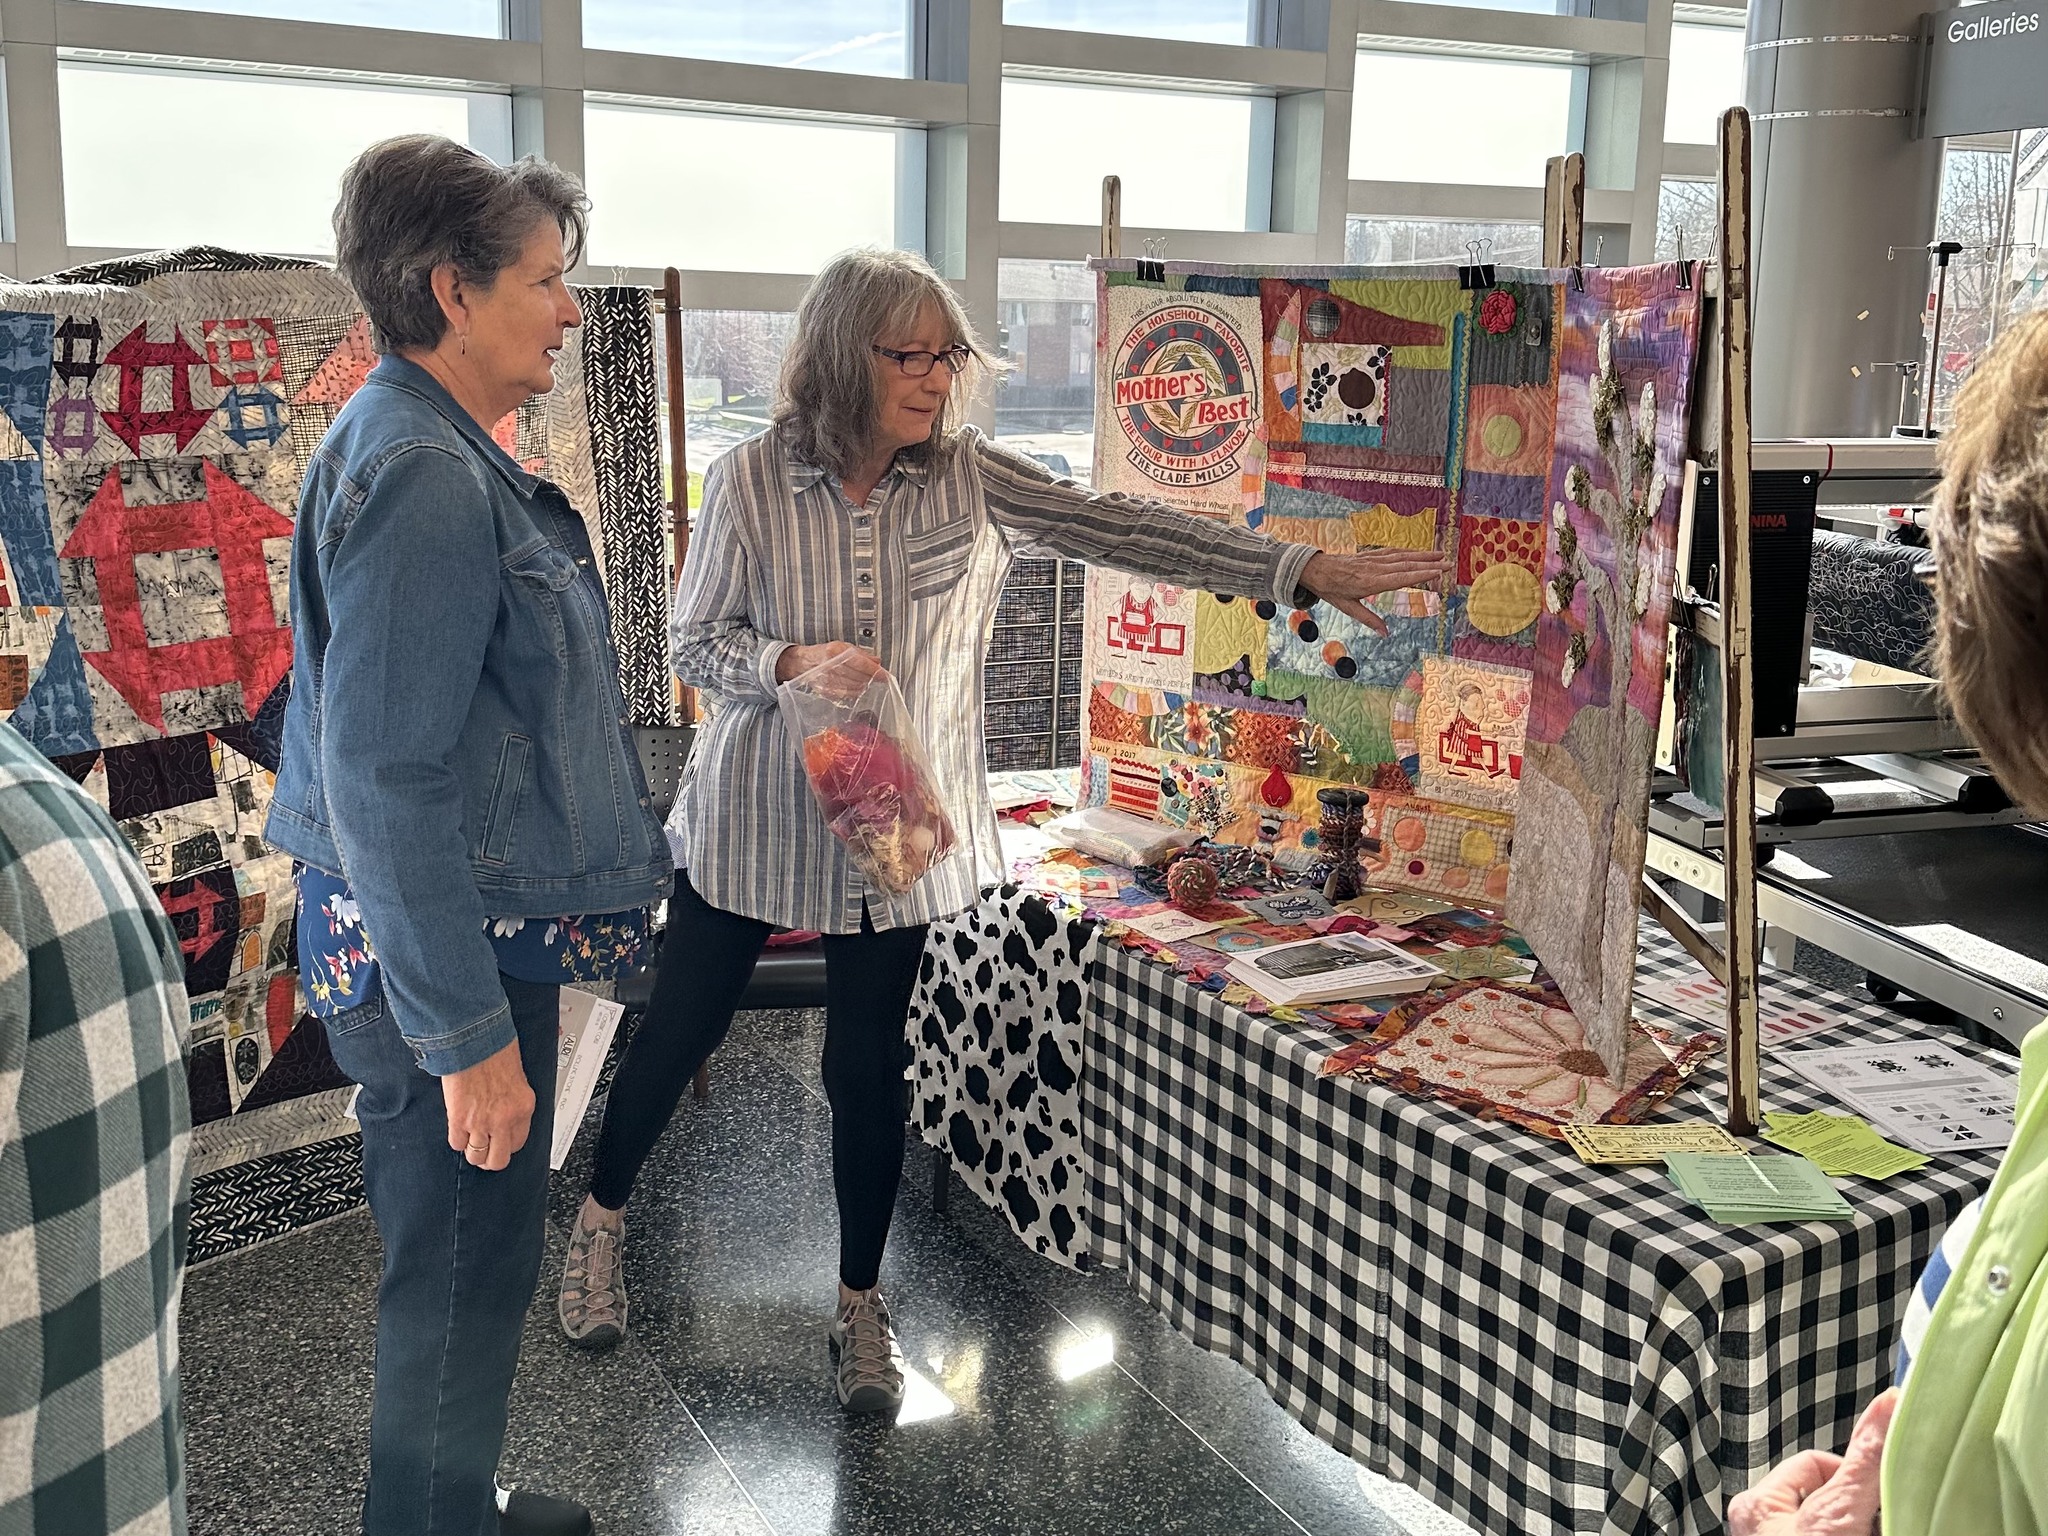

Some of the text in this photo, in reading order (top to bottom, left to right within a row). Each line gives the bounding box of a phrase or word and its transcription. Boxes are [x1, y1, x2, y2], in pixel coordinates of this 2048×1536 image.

[1947, 11, 2039, 43] Galleries
[1130, 309, 1145, 321] THIS
[1165, 294, 1205, 305] ABSOLUTELY
[1205, 300, 1242, 330] GUARANTEED
[1124, 309, 1251, 373] THE HOUSEHOLD FAVORITE
[1116, 372, 1206, 406] Mother's
[1198, 396, 1250, 425] Best
[1121, 414, 1246, 469] THE FLOUR WITH A FLAVOR
[1132, 450, 1235, 484] THE GLADE MILLS
[1163, 496, 1189, 507] Selected
[1190, 497, 1207, 509] Hard
[1208, 500, 1230, 510] Wheat
[1751, 514, 1788, 528] NINA
[1091, 744, 1137, 759] JULY 1 2017
